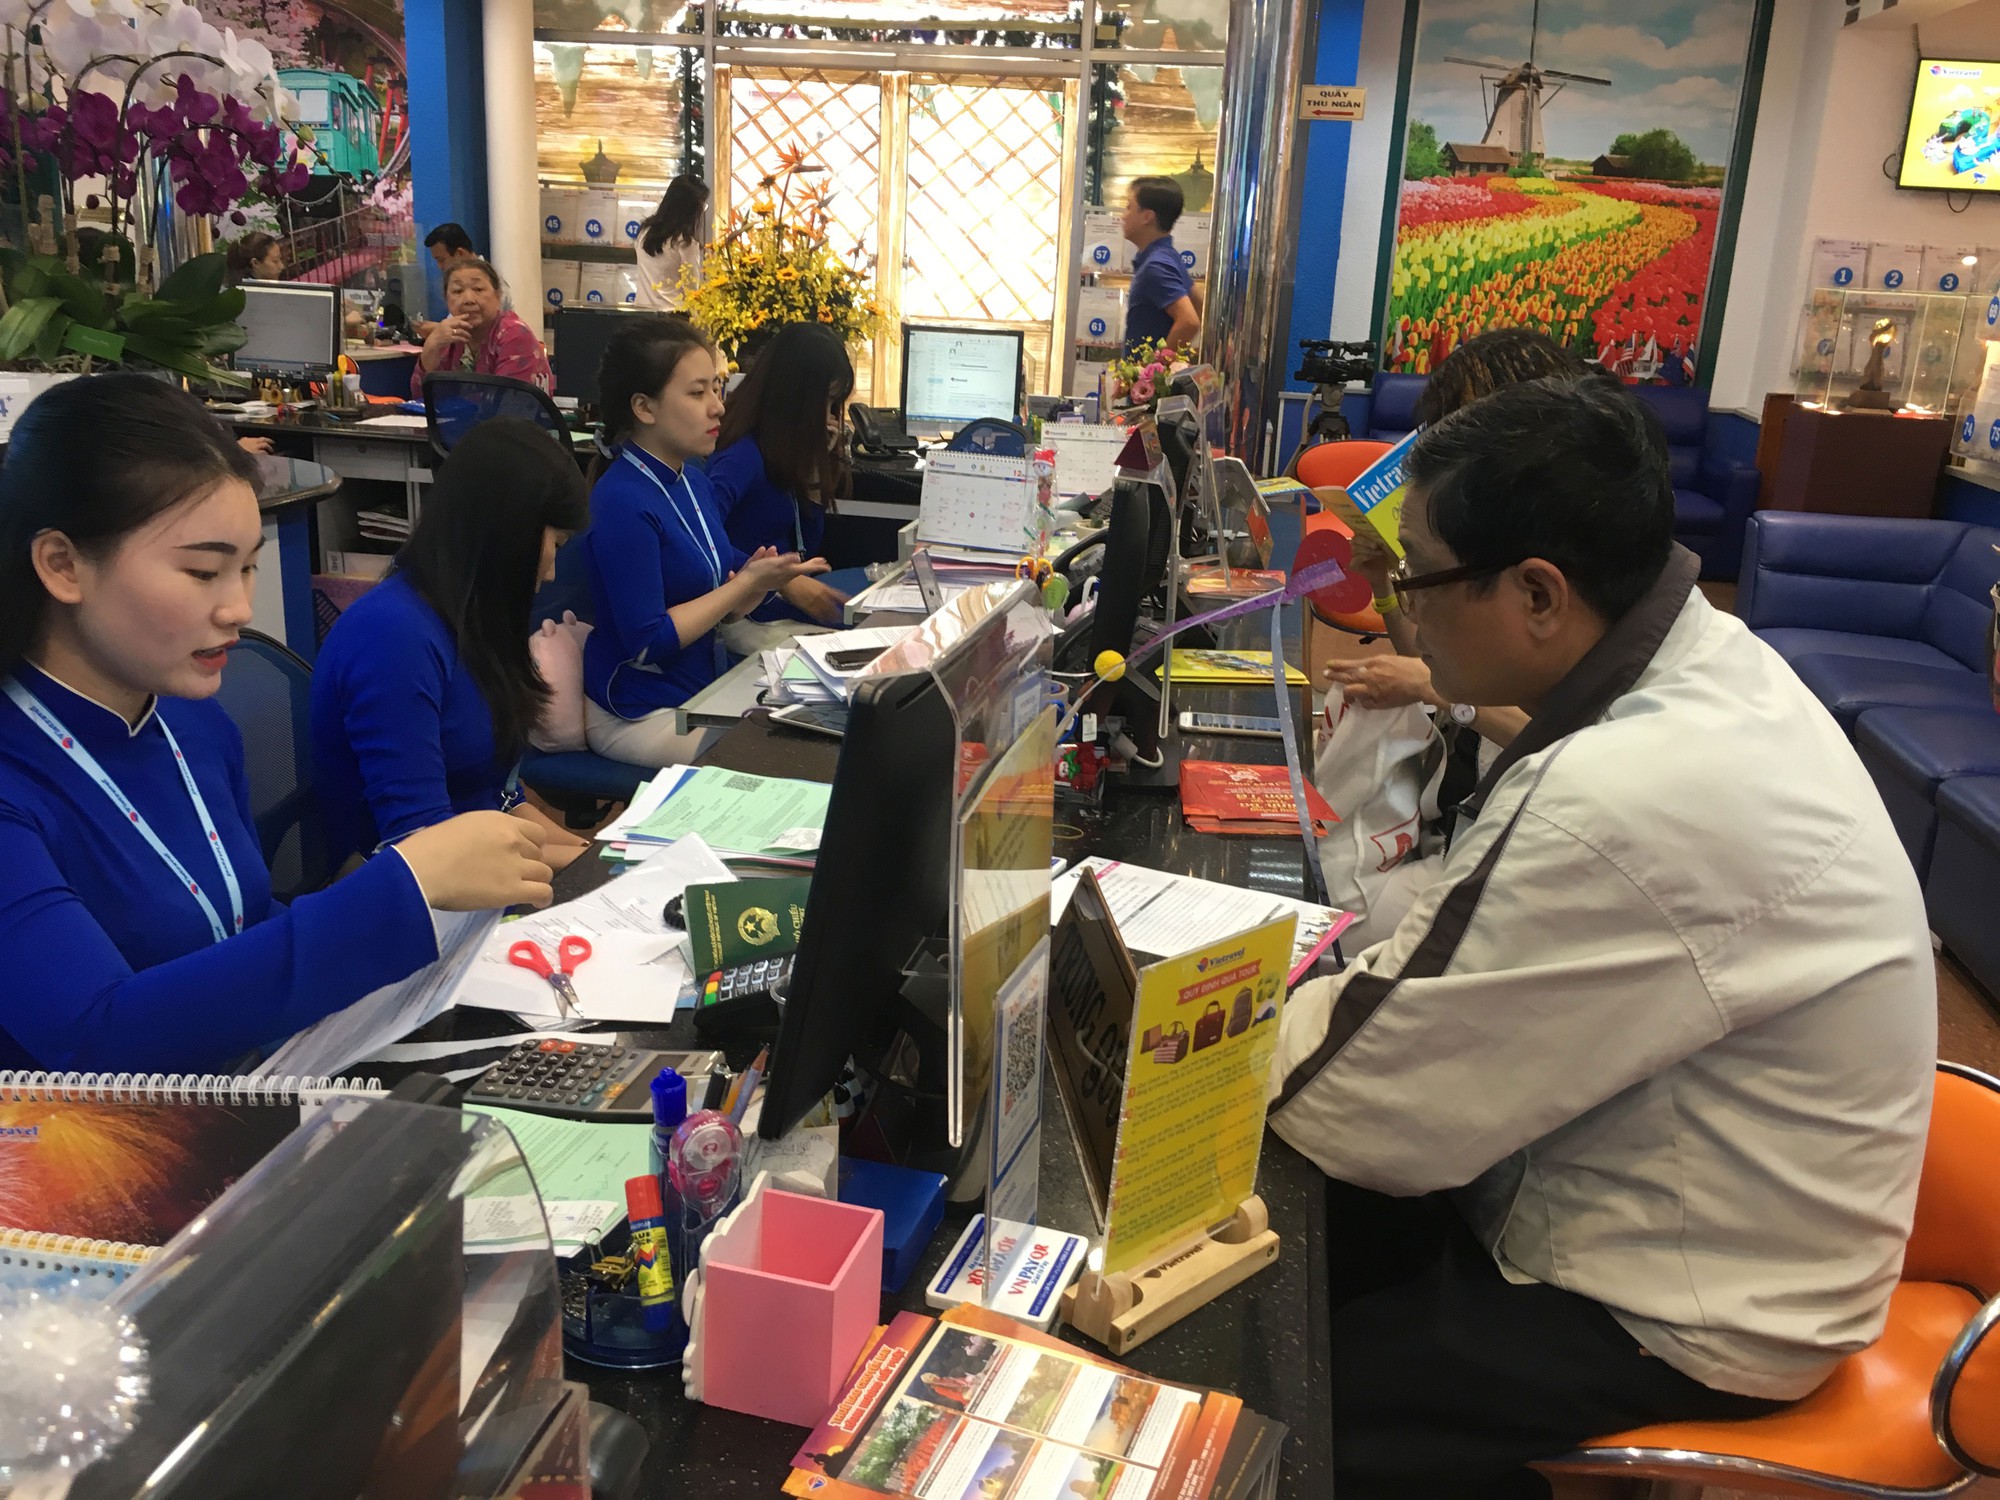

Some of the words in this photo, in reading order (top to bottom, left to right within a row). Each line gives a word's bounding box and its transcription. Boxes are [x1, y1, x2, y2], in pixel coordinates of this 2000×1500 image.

[547, 220, 558, 228] 45
[588, 224, 599, 232] 46
[627, 226, 638, 234] 47
[1096, 250, 1107, 260] 57
[1182, 256, 1193, 264] 59
[1840, 270, 1846, 282] 1
[1889, 272, 1899, 285] 2
[1944, 277, 1954, 288] 3
[549, 292, 560, 300] 49
[1092, 322, 1102, 332] 61
[1964, 422, 1973, 436] 74
[1992, 426, 2000, 441] 75
[1352, 463, 1406, 510] Vietra
[1209, 948, 1246, 966] Vietravel
[0, 1126, 38, 1136] ravel
[1157, 1244, 1203, 1272] Vietravel
[1008, 1244, 1049, 1294] VNPAYQR
